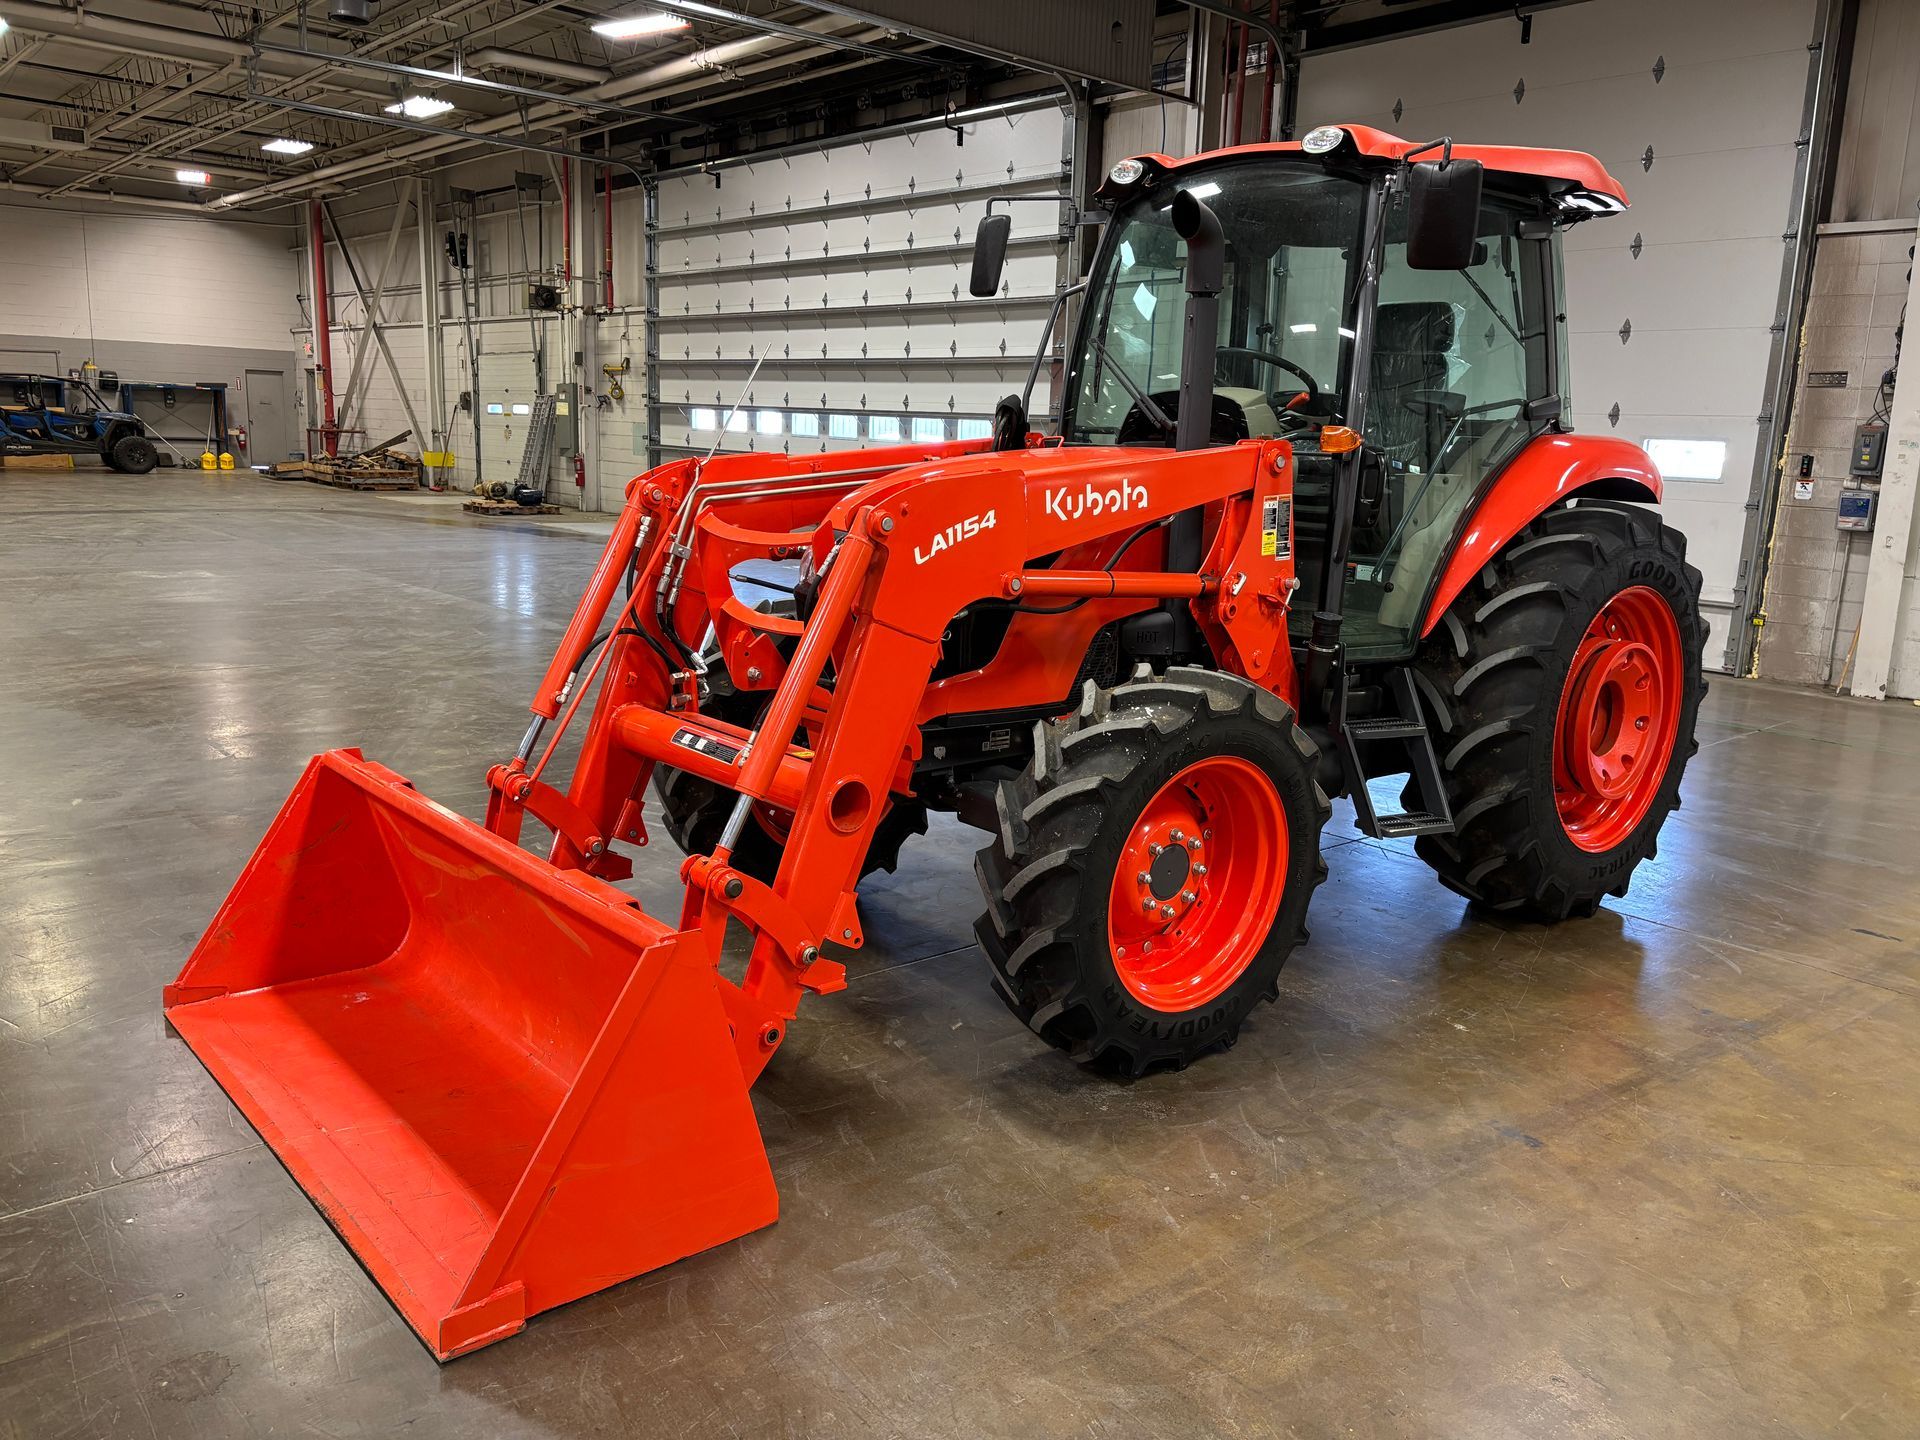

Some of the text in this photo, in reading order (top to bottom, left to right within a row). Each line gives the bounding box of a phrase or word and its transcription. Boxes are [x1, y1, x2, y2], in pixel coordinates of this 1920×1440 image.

[1045, 478, 1148, 522] Kubota
[913, 508, 997, 566] LA1154
[1136, 631, 1160, 644] HOT
[1102, 982, 1241, 1041] GOODYEAR
